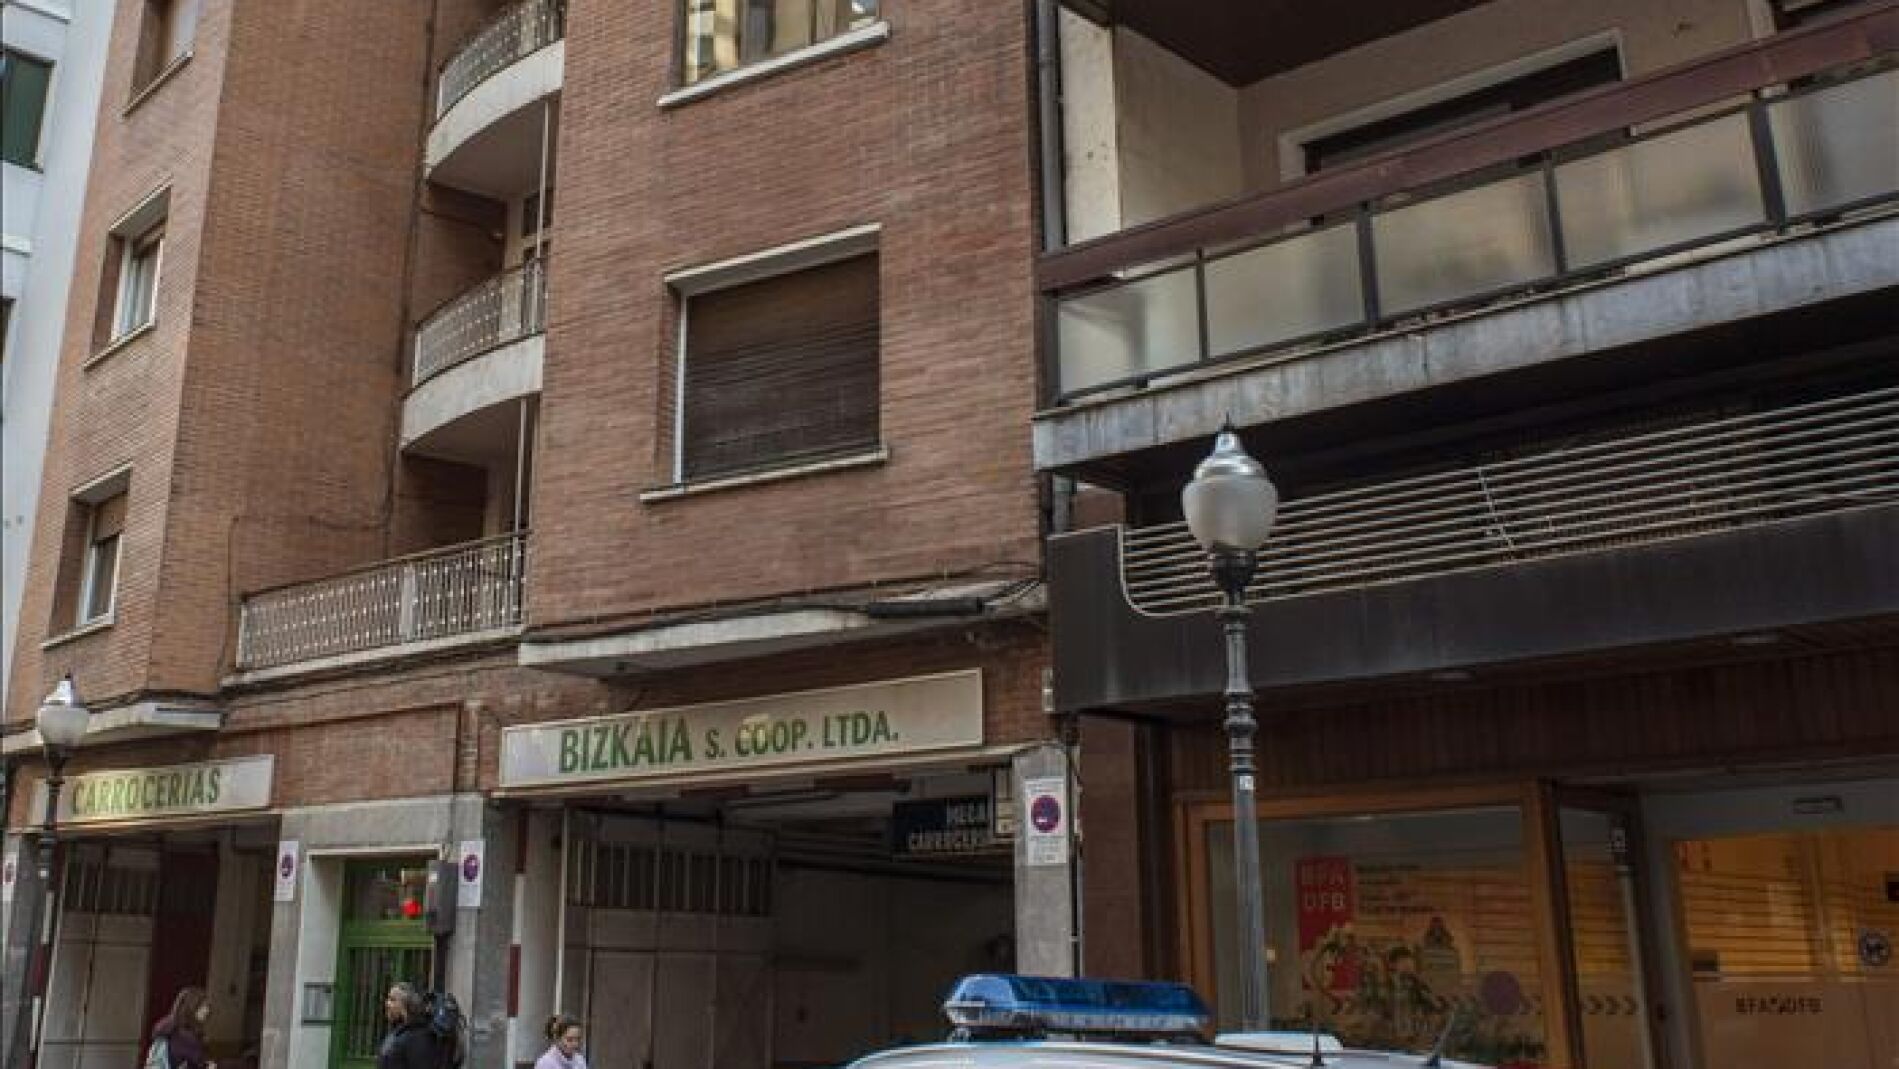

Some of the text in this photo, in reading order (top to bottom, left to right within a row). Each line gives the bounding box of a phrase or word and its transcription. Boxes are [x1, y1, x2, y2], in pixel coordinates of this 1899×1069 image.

[559, 717, 693, 773] BIZKAIA
[735, 719, 815, 756] COOP.
[822, 711, 899, 747] LTDA.
[72, 767, 221, 816] CARROCERIAS
